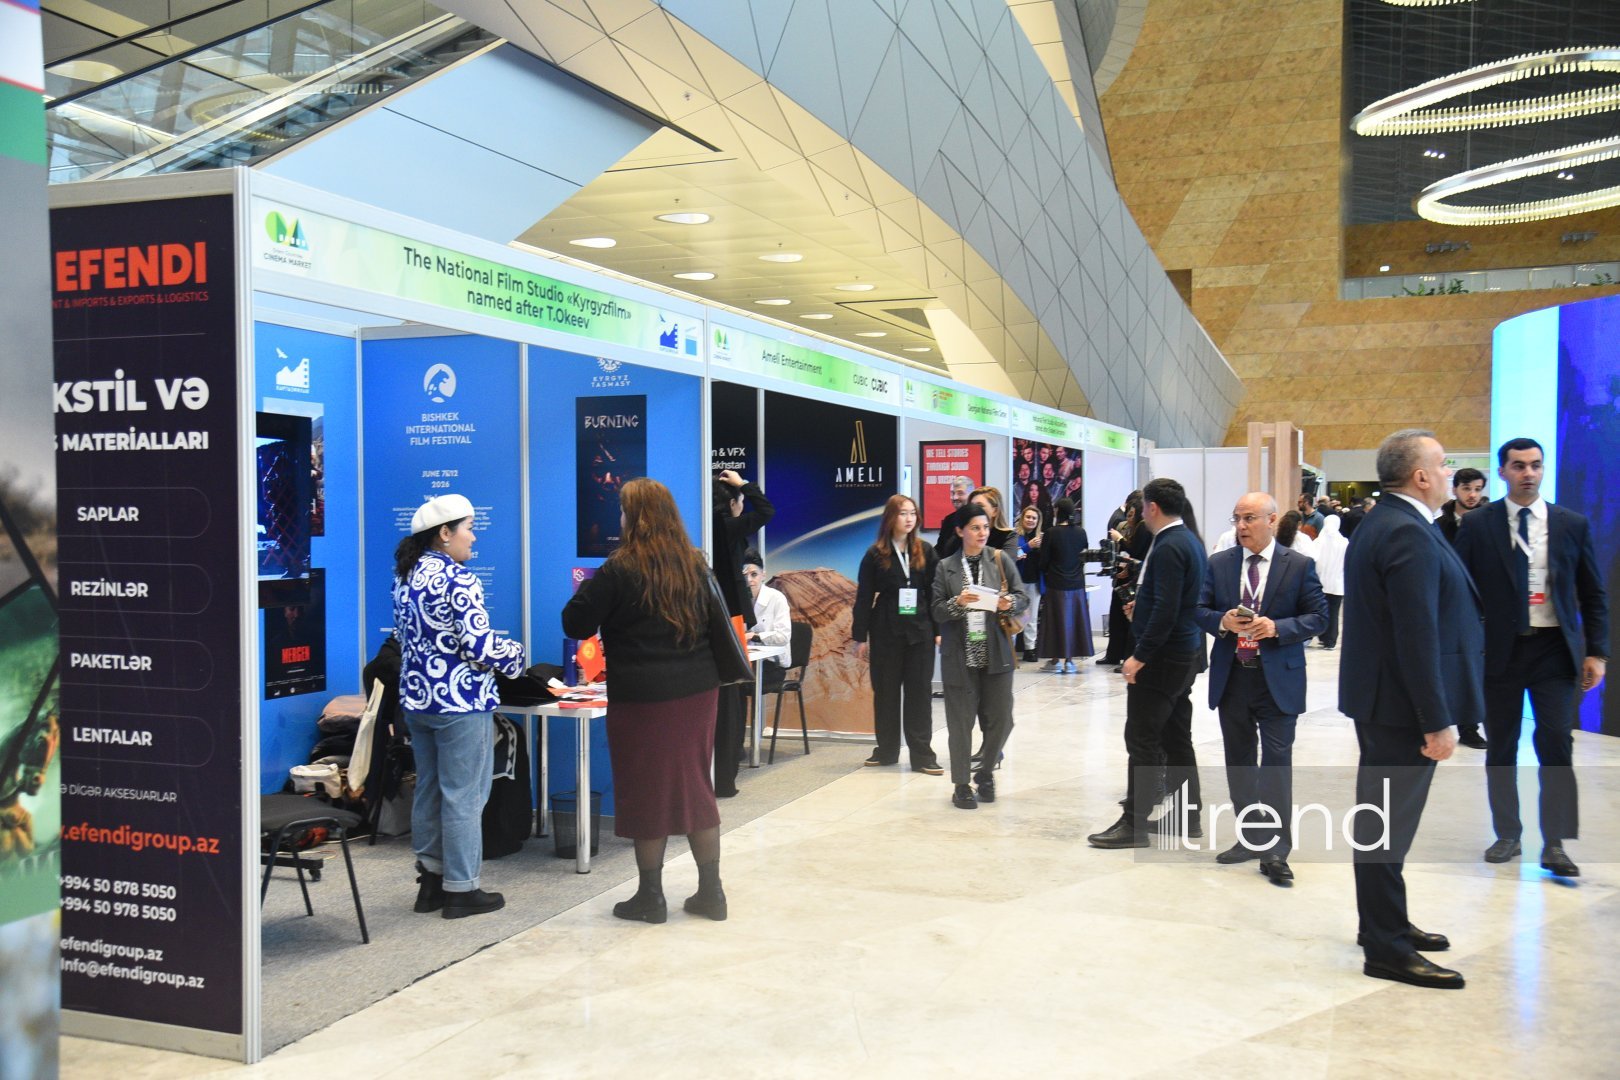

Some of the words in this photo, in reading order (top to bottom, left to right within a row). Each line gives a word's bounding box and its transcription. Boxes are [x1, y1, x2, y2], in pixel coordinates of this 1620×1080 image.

[55, 242, 207, 292] EFENDI
[263, 252, 287, 264] CINEMA
[288, 258, 312, 270] MARKET
[403, 247, 432, 270] The
[436, 255, 493, 286] National
[497, 272, 524, 293] Film
[527, 281, 564, 304] Studio
[567, 292, 632, 320] «Kyrgyzfilm»
[72, 296, 109, 308] IMPORTS
[118, 294, 155, 306] EXPORTS
[165, 291, 209, 303] LOGISTICS
[467, 288, 513, 313] named
[516, 300, 544, 321] after
[547, 305, 590, 330] T.Okeev
[762, 349, 780, 365] Ameli
[781, 354, 822, 375] Entertainment
[591, 380, 631, 388] TASMASY
[592, 374, 629, 382] KYRGYZ
[53, 368, 147, 413] KSTİL
[154, 377, 210, 411] VƏ
[421, 412, 460, 422] BISHKEK
[584, 414, 640, 429] BURNING
[405, 423, 476, 434] INTERNATIONAL
[62, 426, 209, 451] MATERİALLARI
[410, 436, 430, 446] FILM
[431, 435, 472, 445] FESTIVAL
[718, 447, 725, 457] &
[727, 447, 745, 457] VFX
[422, 470, 440, 478] JUNE
[835, 466, 882, 483] AMELI
[431, 480, 450, 488] 2026
[77, 506, 140, 522] SAPLAR
[70, 577, 149, 598] REZİNLƏR
[70, 653, 152, 671] PAKETLƏR
[281, 646, 311, 664] MERGEN
[73, 727, 153, 747] LENTALAR
[69, 782, 102, 797] DİGƏR
[103, 787, 178, 803] AKSESUARLAR
[93, 878, 111, 893] 50
[113, 881, 140, 896] 878
[142, 883, 177, 900] 5050
[93, 900, 111, 915] 50
[113, 902, 140, 918] 978
[142, 905, 177, 922] 5050
[60, 936, 164, 962] efendigroup.az
